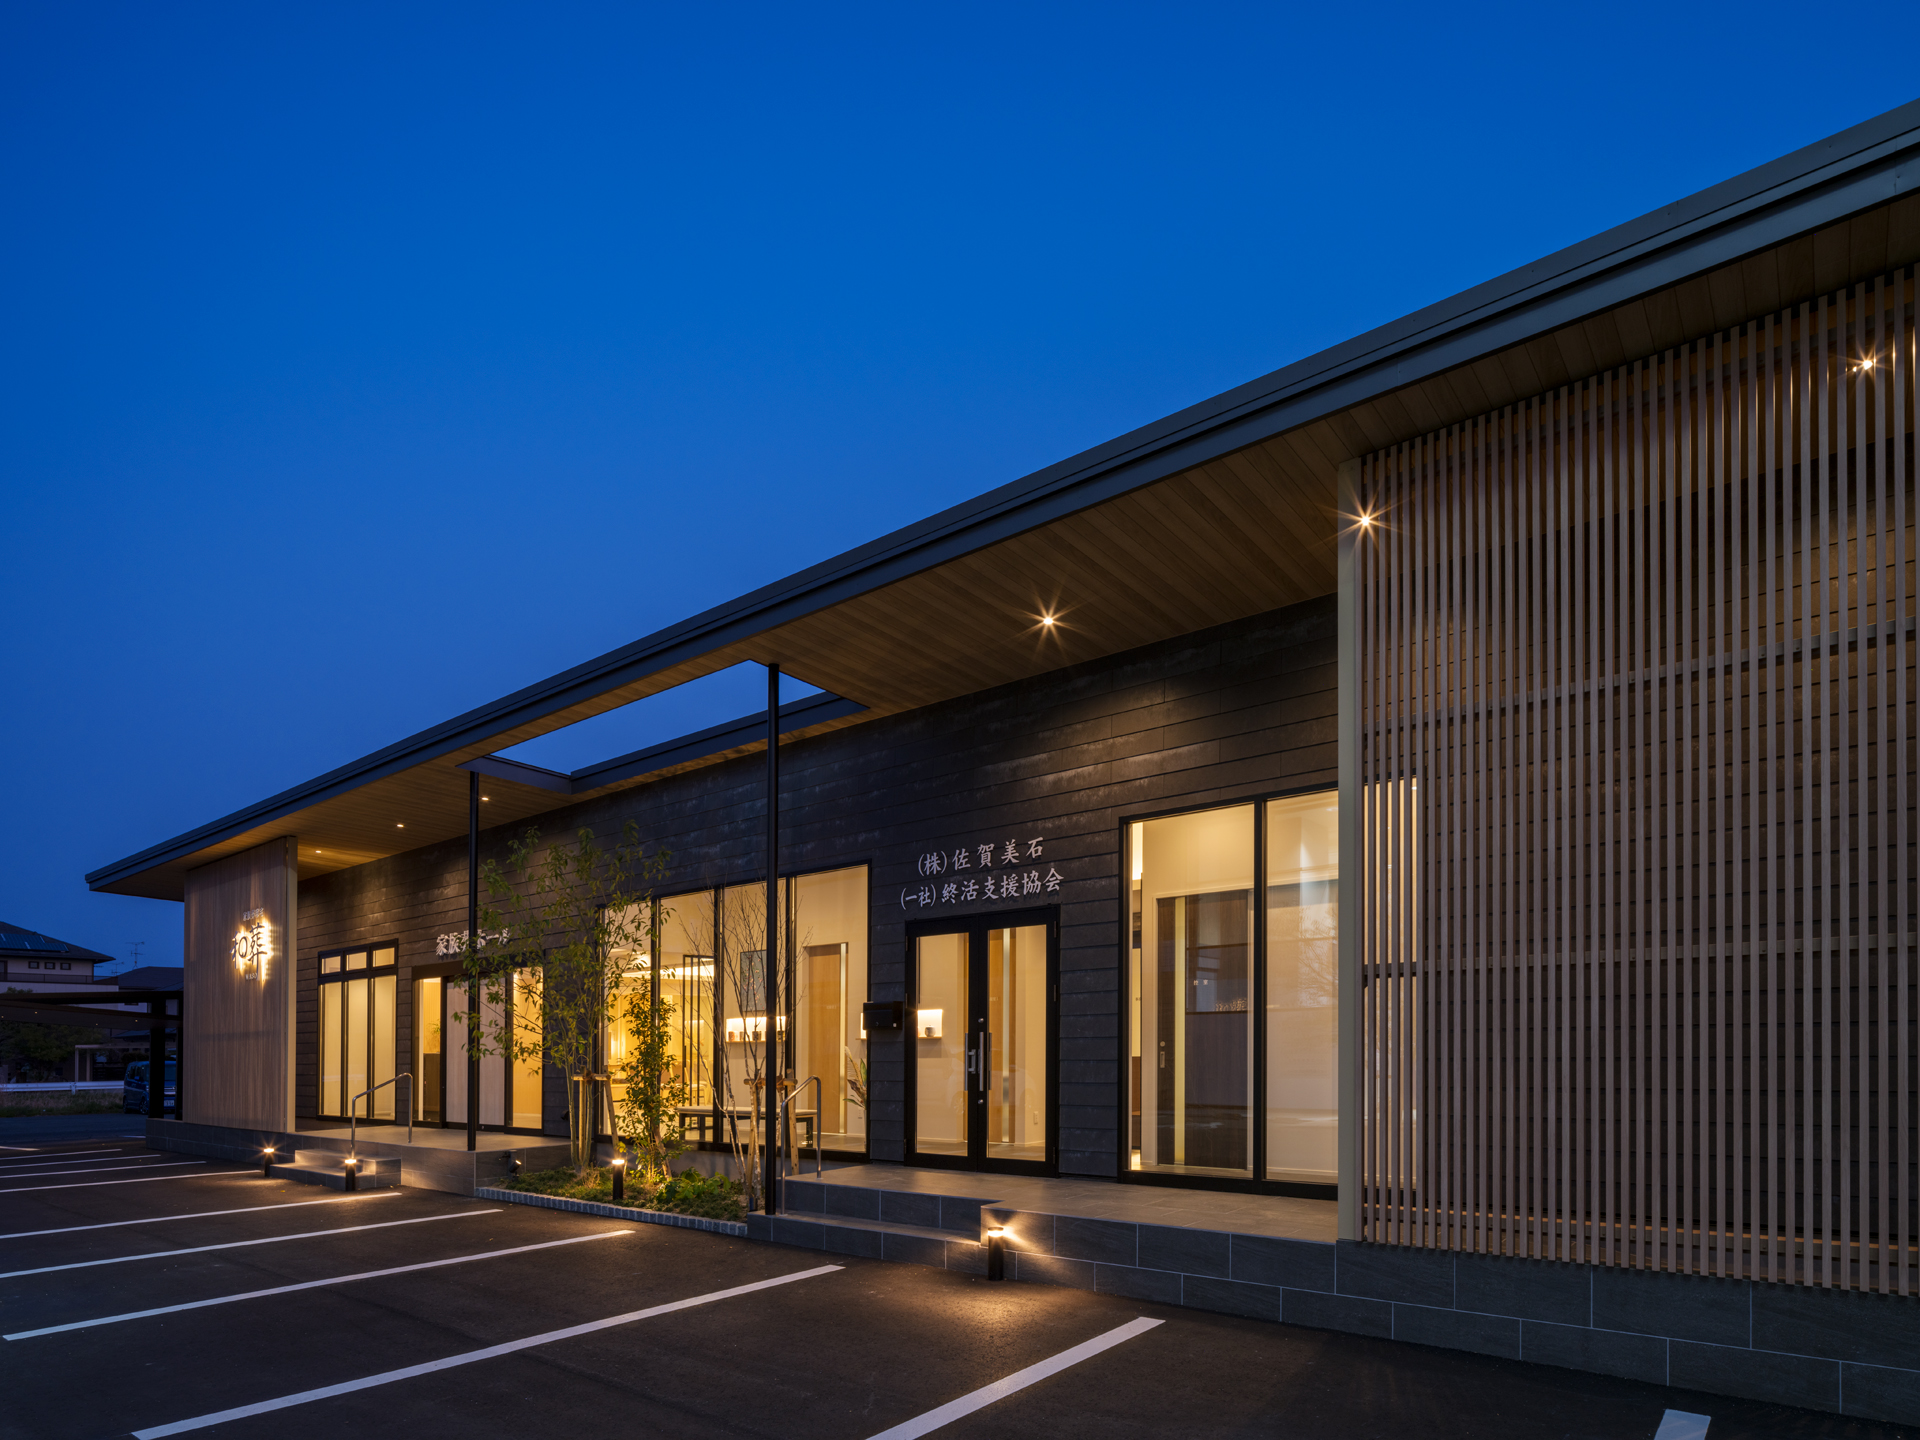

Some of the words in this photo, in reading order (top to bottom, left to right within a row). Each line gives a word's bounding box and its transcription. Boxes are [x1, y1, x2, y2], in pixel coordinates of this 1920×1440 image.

[918, 837, 1044, 876] (株)佐賀美石
[901, 868, 1064, 910] (一社)終活支援協会
